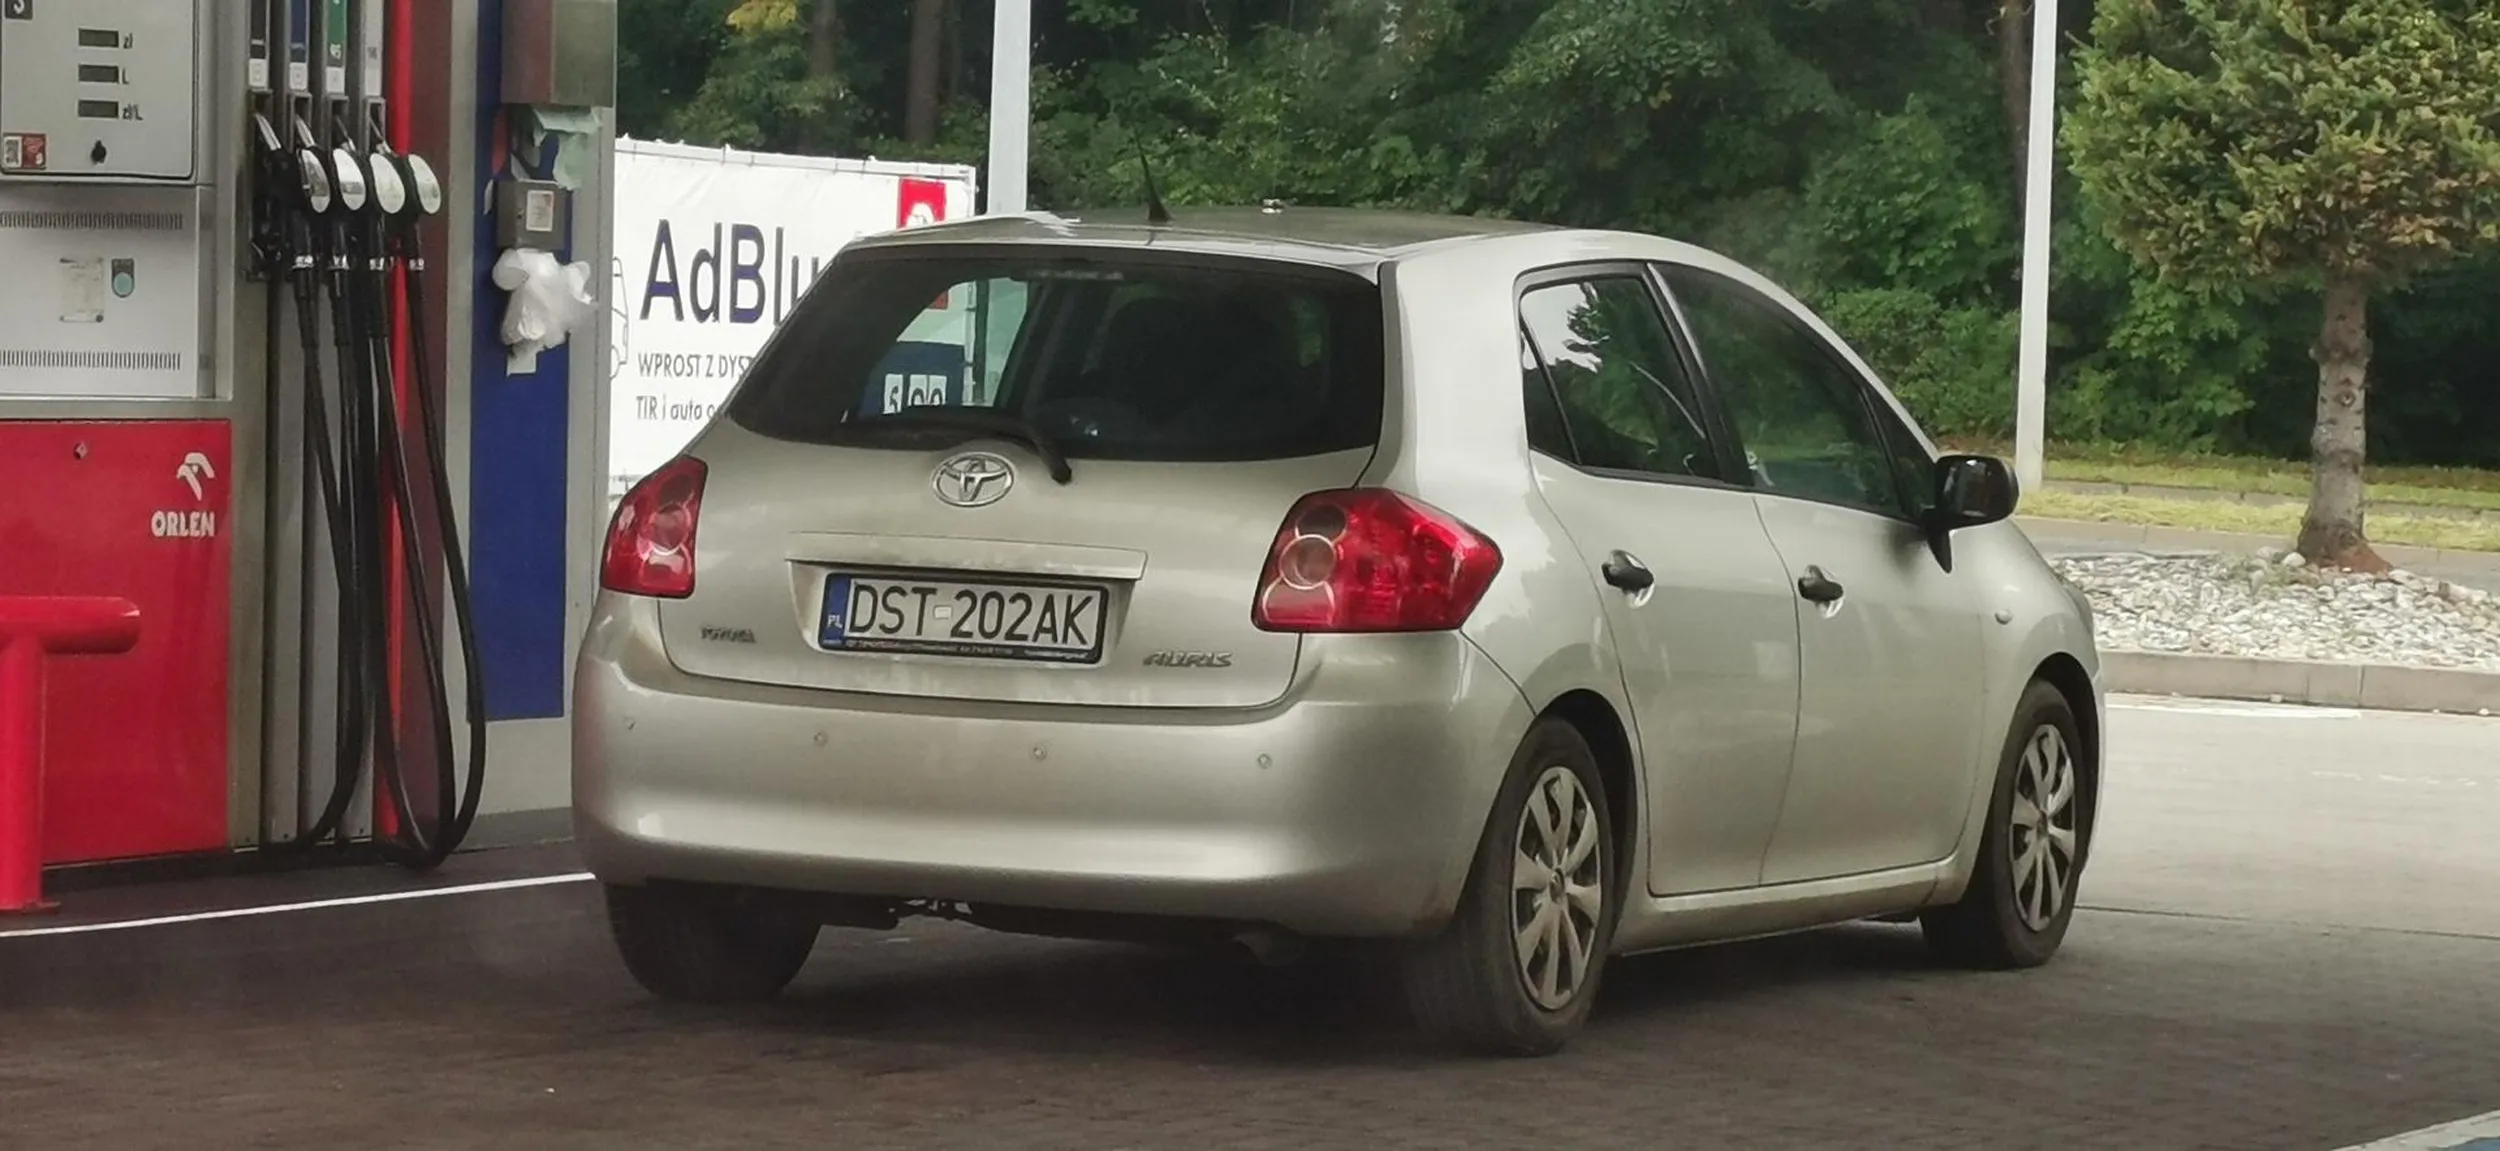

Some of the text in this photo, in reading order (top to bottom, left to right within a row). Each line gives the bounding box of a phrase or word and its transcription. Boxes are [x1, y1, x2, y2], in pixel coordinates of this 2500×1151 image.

[637, 353, 701, 378] WPROST
[705, 354, 713, 378] Z
[636, 395, 658, 420] TIR
[670, 400, 703, 421] auto
[151, 510, 215, 537] ORLEN
[848, 584, 1093, 645] DST 202AK
